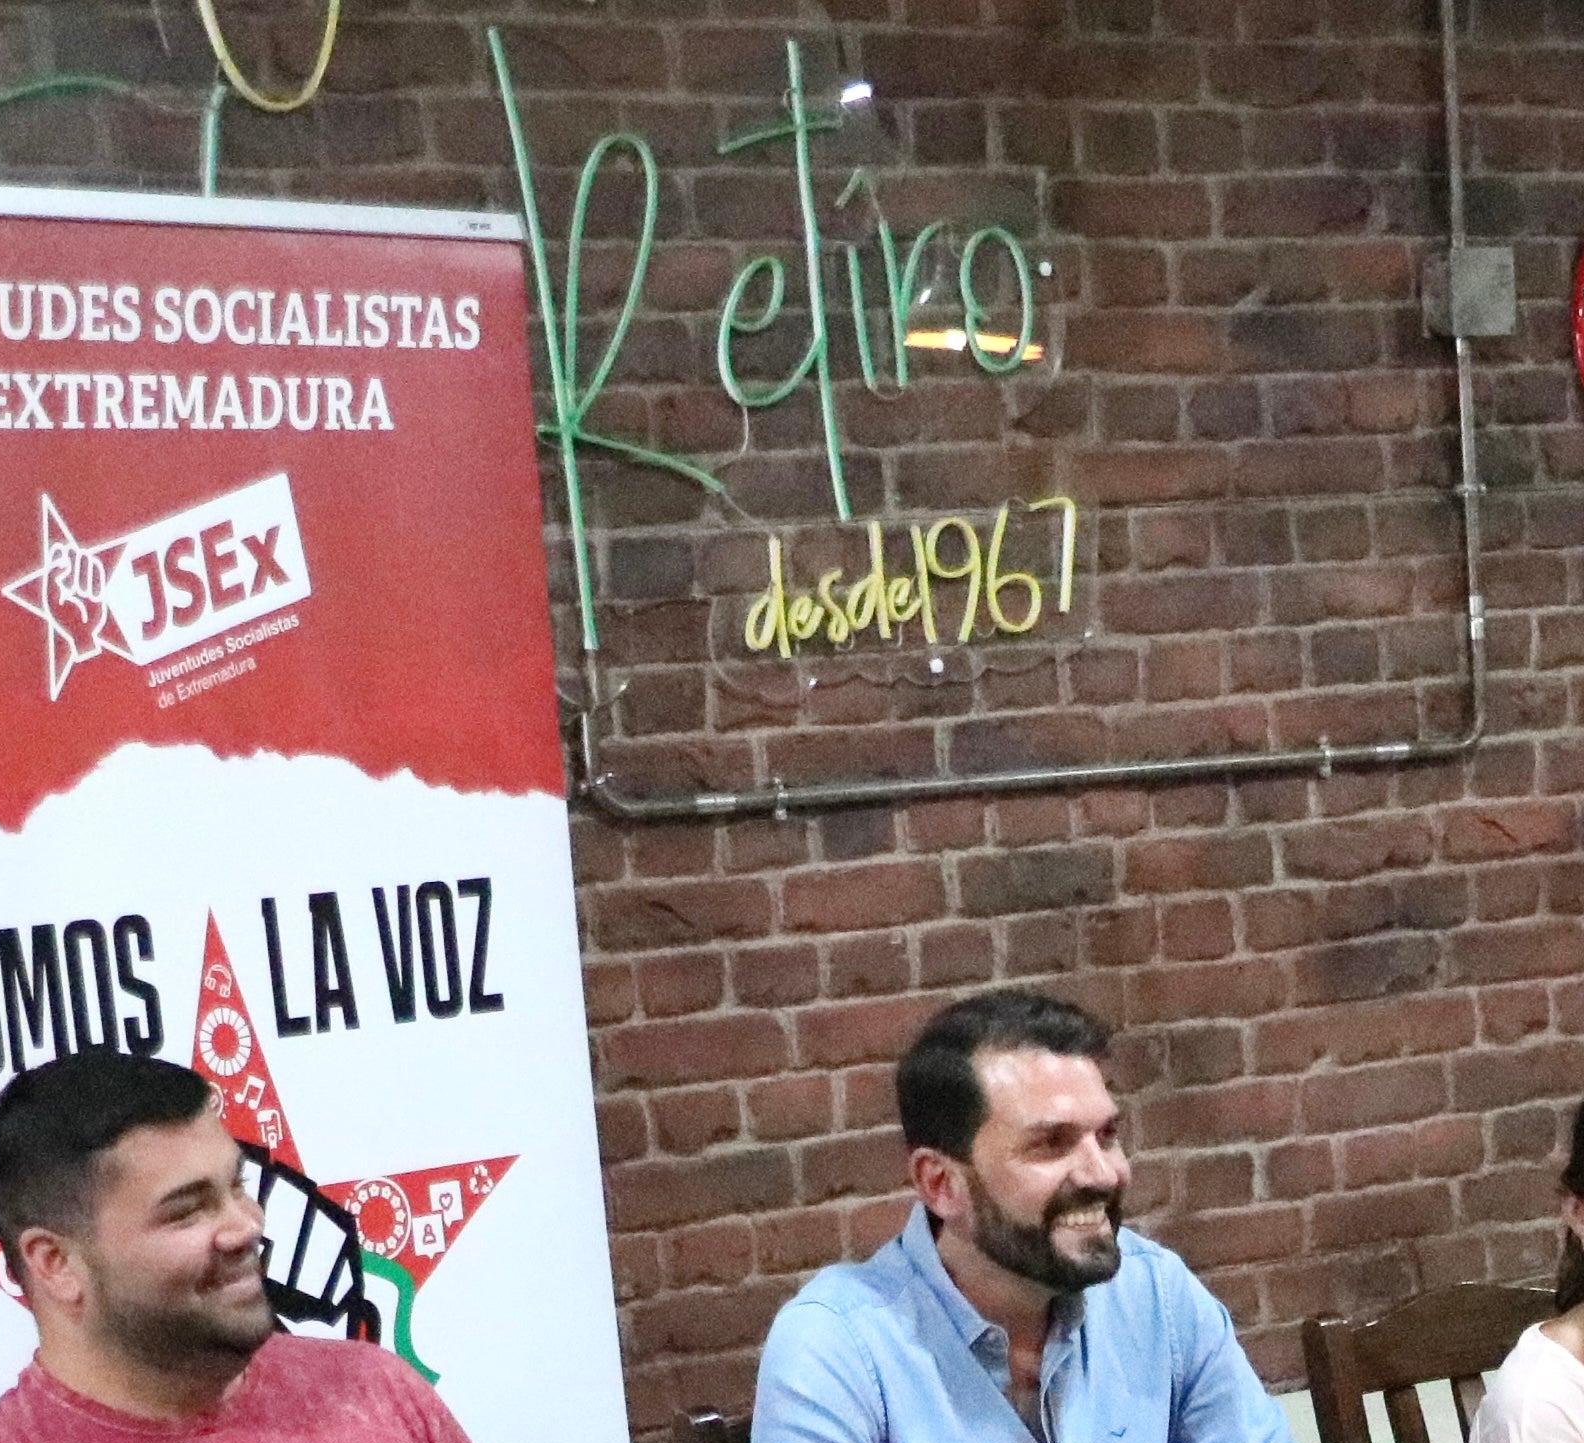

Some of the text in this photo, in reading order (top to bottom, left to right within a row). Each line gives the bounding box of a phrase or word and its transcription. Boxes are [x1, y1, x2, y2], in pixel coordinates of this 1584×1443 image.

[153, 286, 483, 351] SOCIALISTAS
[130, 518, 291, 644] JSEx
[744, 496, 1077, 660] desde 1967
[148, 613, 300, 688] Juventudes Socialistas
[157, 657, 257, 709] de Extremadura
[261, 891, 361, 1039] LA
[371, 876, 506, 1024] VOZ
